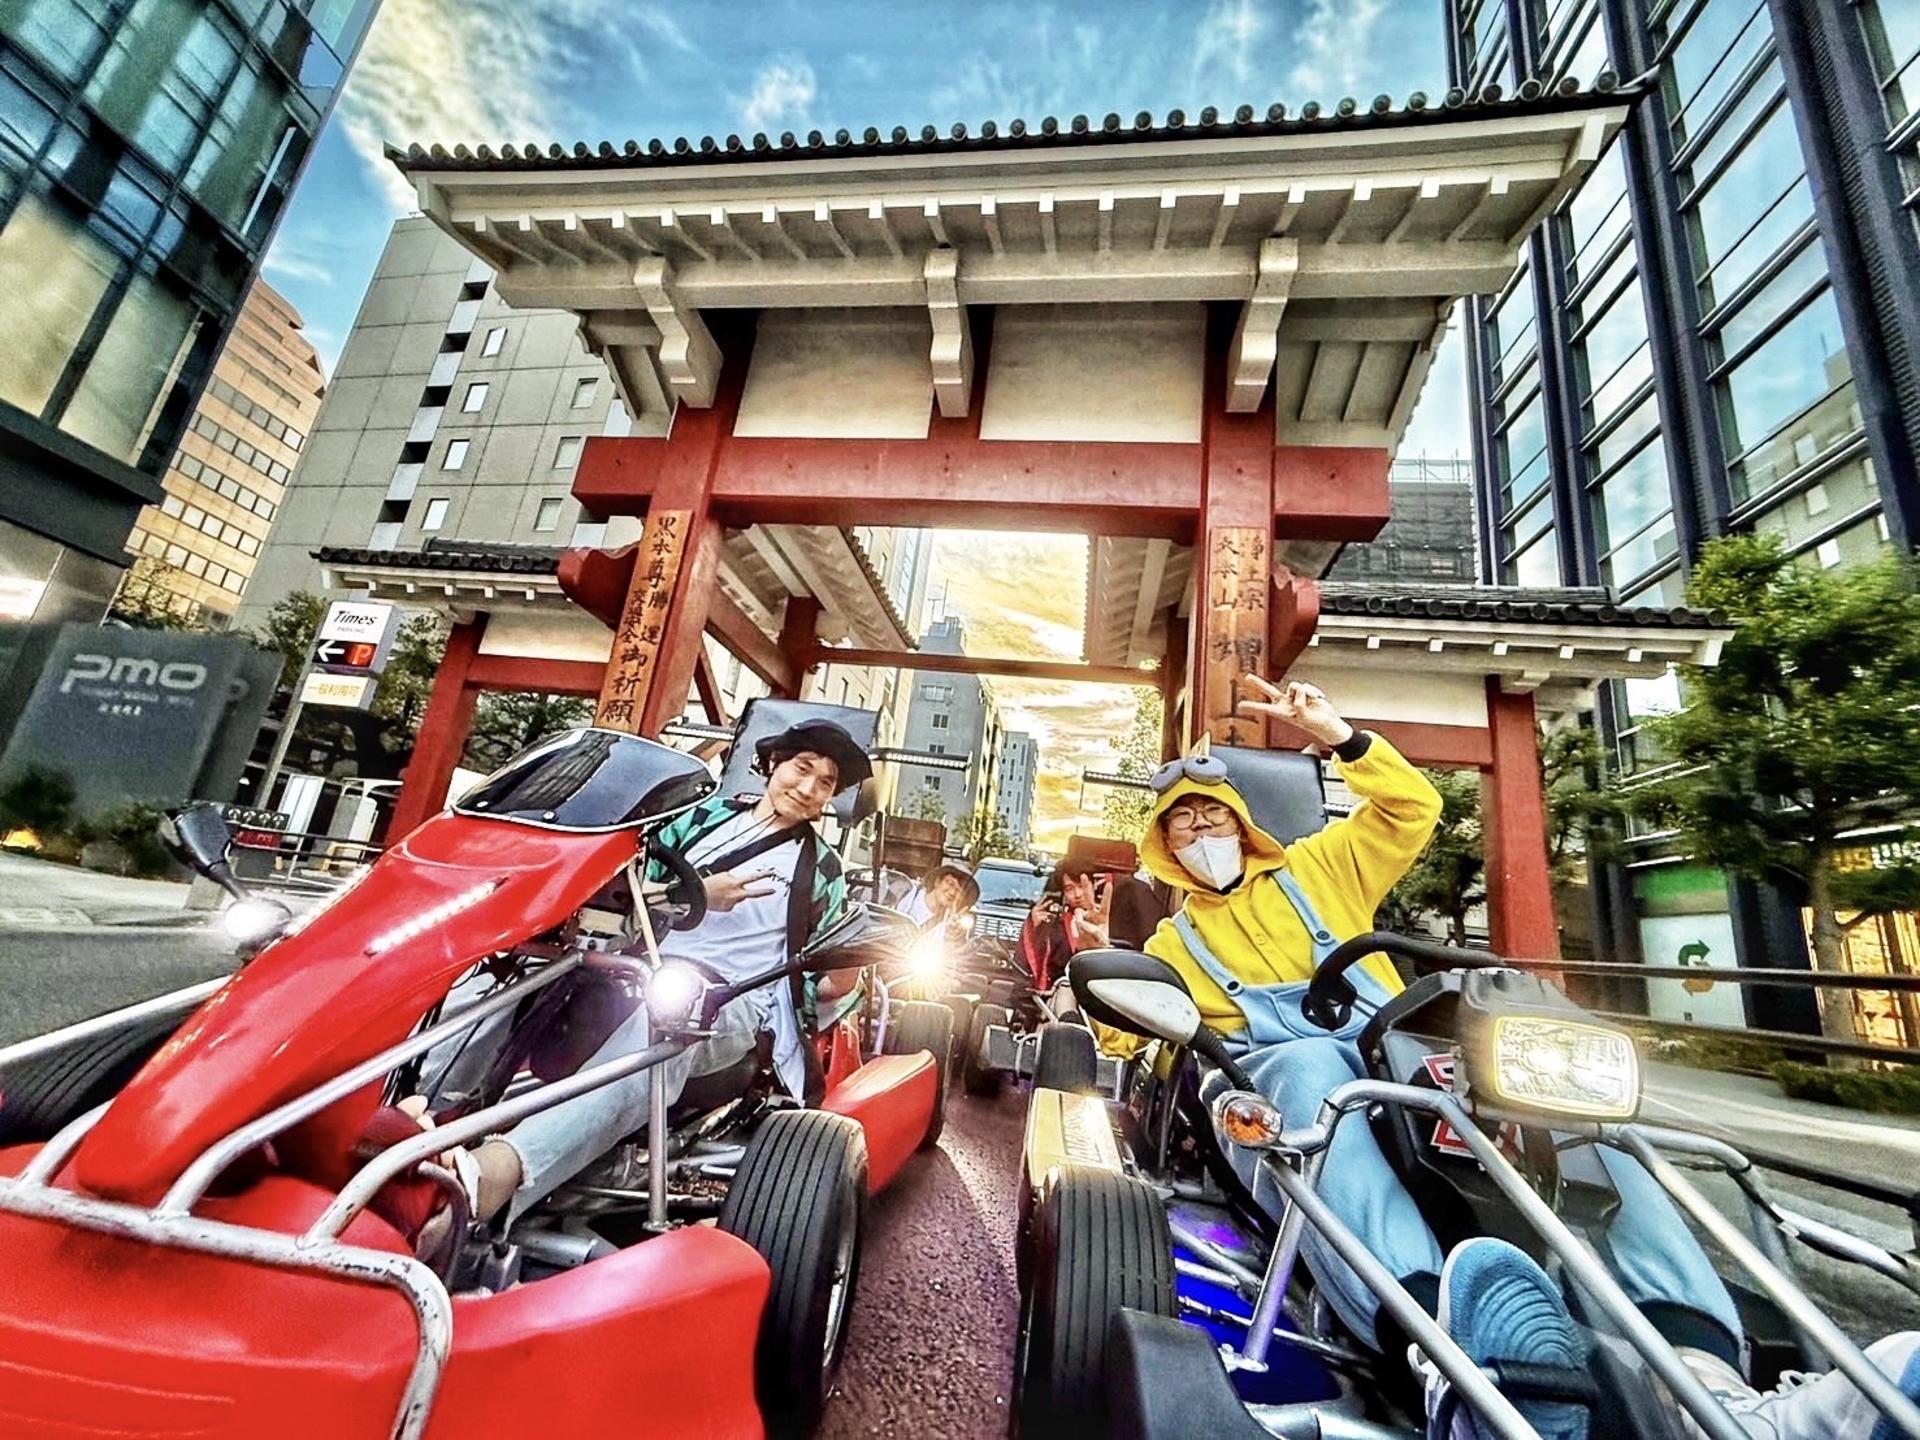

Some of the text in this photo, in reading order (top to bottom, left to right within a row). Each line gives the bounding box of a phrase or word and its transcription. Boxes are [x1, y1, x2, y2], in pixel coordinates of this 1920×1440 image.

[333, 610, 378, 625] Times
[352, 644, 373, 665] P
[60, 653, 208, 694] pmo
